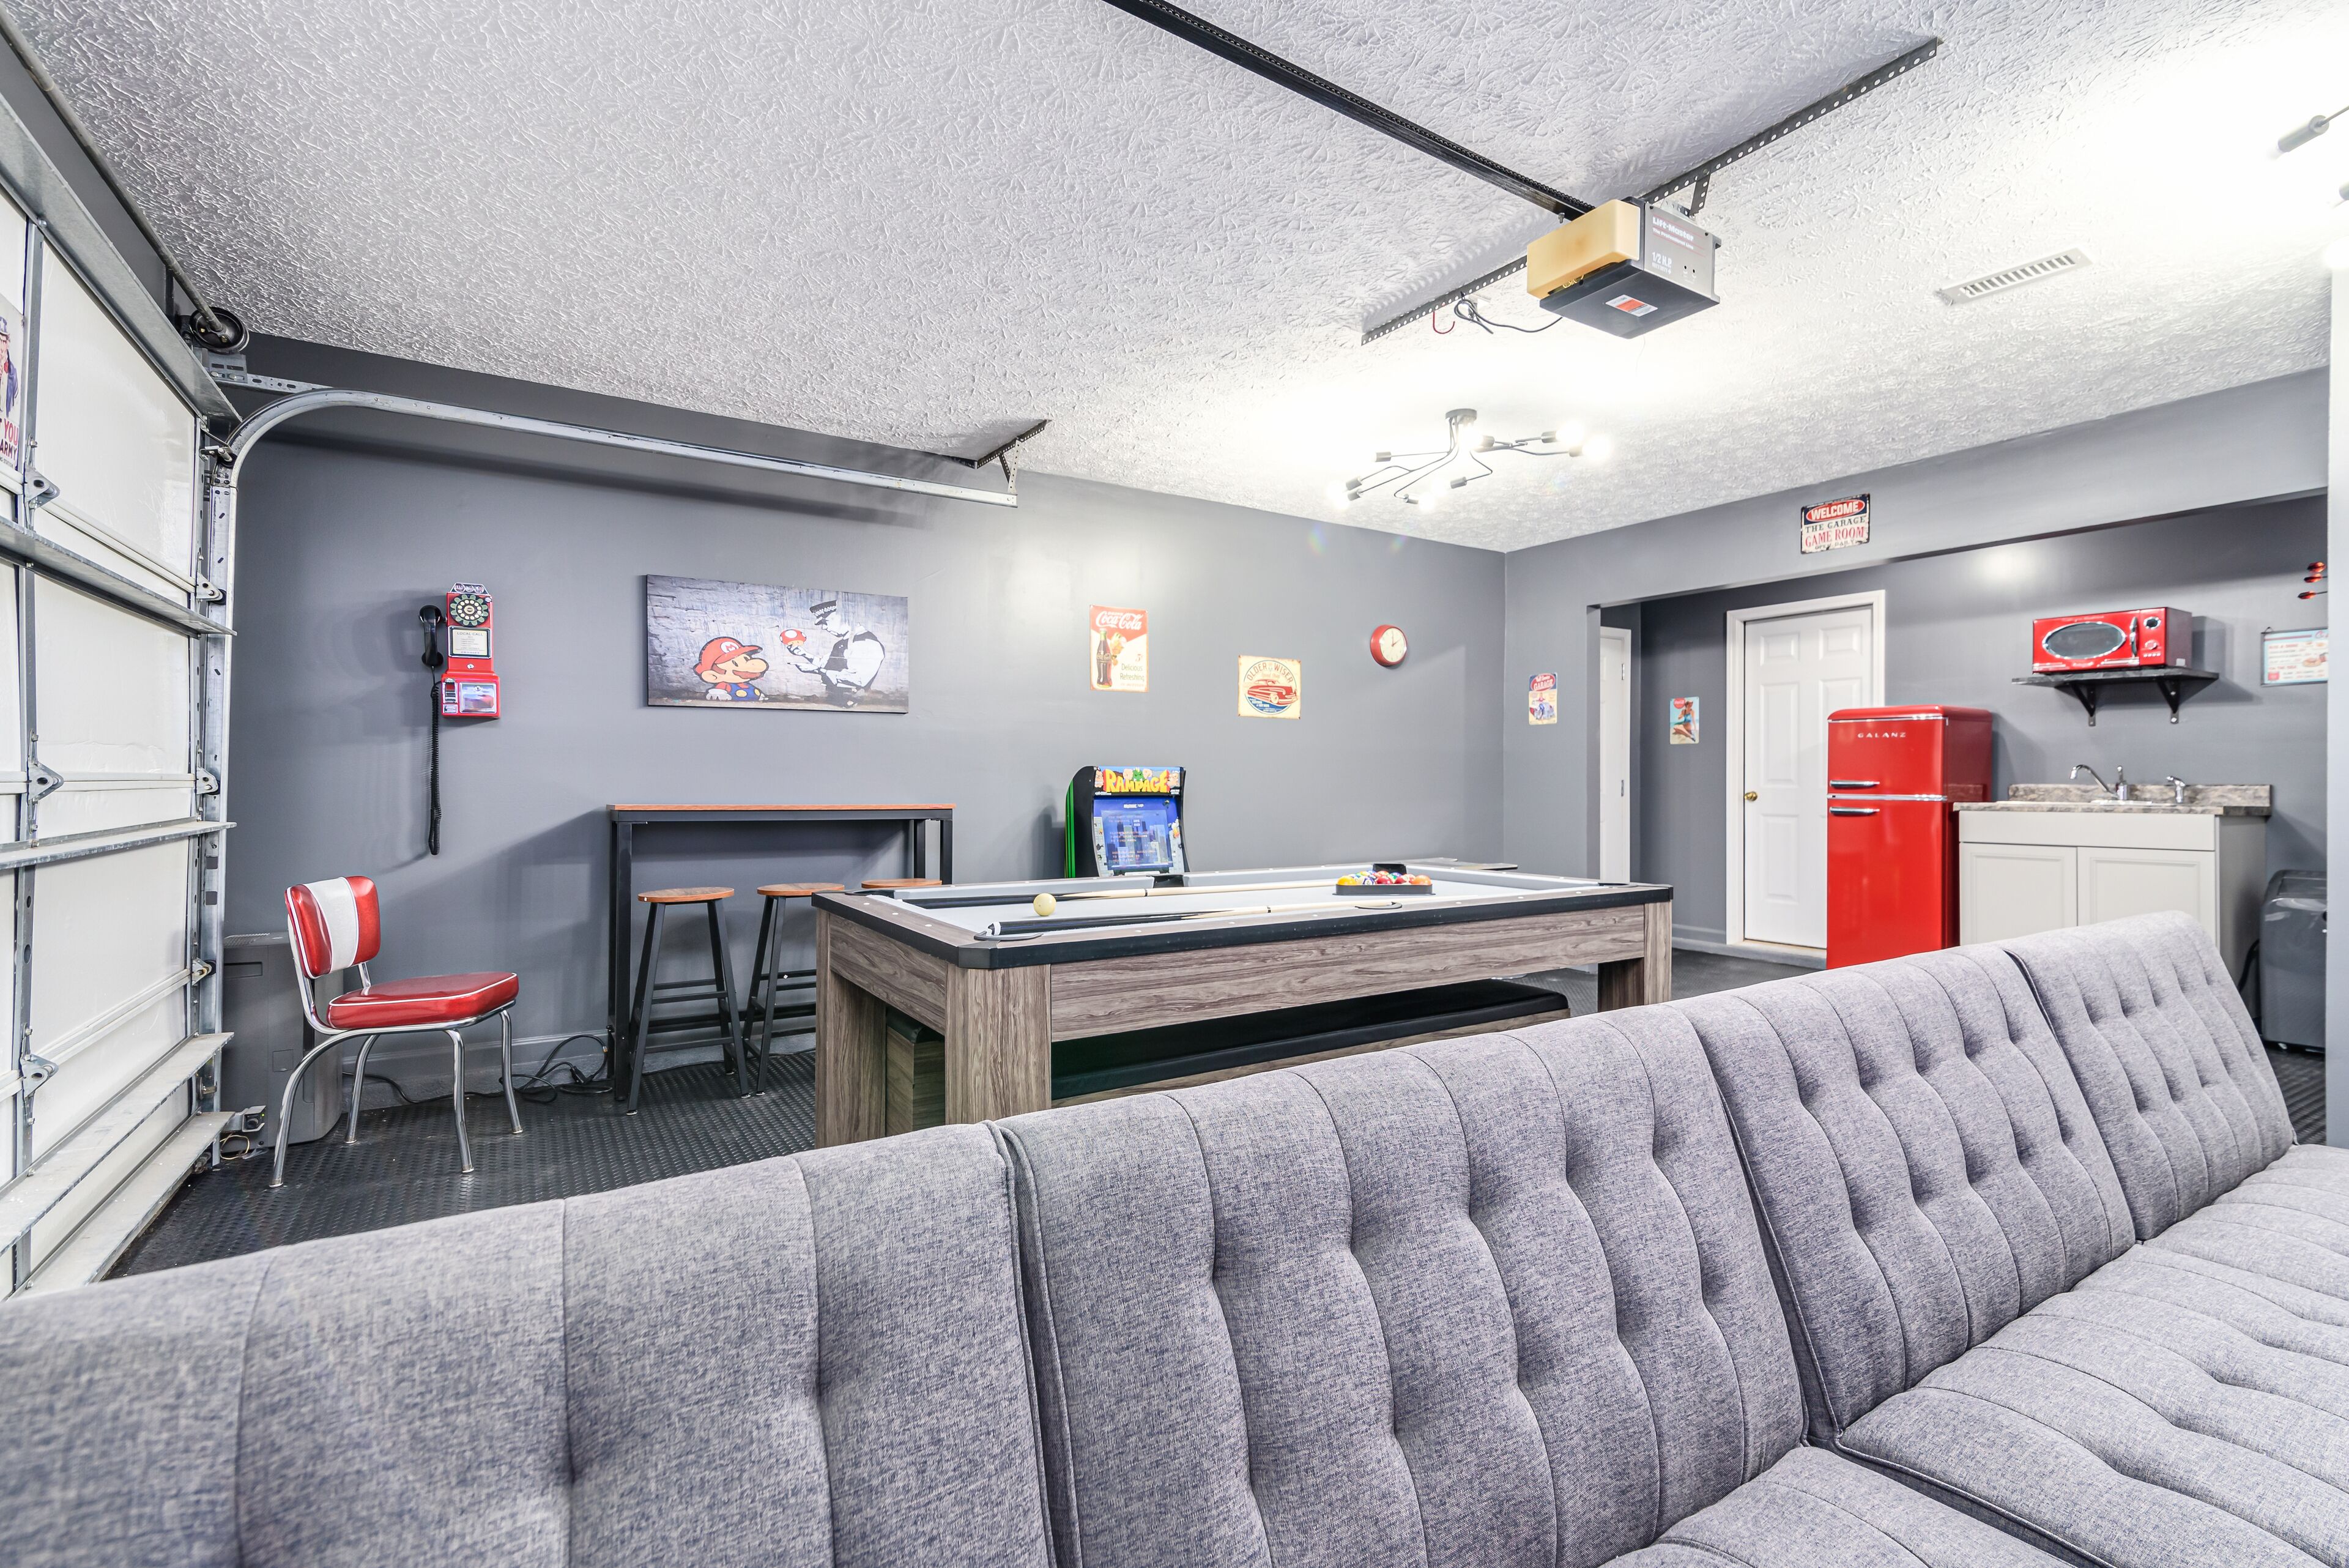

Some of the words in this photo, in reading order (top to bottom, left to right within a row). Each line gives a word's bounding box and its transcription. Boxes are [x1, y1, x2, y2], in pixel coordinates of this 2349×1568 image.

[1652, 216, 1694, 242] Lift-Master
[1661, 230, 1685, 246] Professional
[1652, 251, 1661, 264] 1/2
[4, 418, 18, 446] YOU
[0, 439, 17, 461] ARMY
[1810, 500, 1860, 521] WELCOME
[1805, 524, 1824, 533] THE
[1827, 516, 1866, 529] GARAGE
[1805, 530, 1832, 548] GAME
[1835, 526, 1865, 540] ROOM
[1096, 611, 1143, 630] Coca-Cola
[1120, 672, 1145, 682] Refreshing
[1121, 663, 1143, 672] Delicious
[1246, 662, 1267, 681] OLDER
[1274, 663, 1294, 683] WISER
[1104, 768, 1171, 793] RAMPAGE
